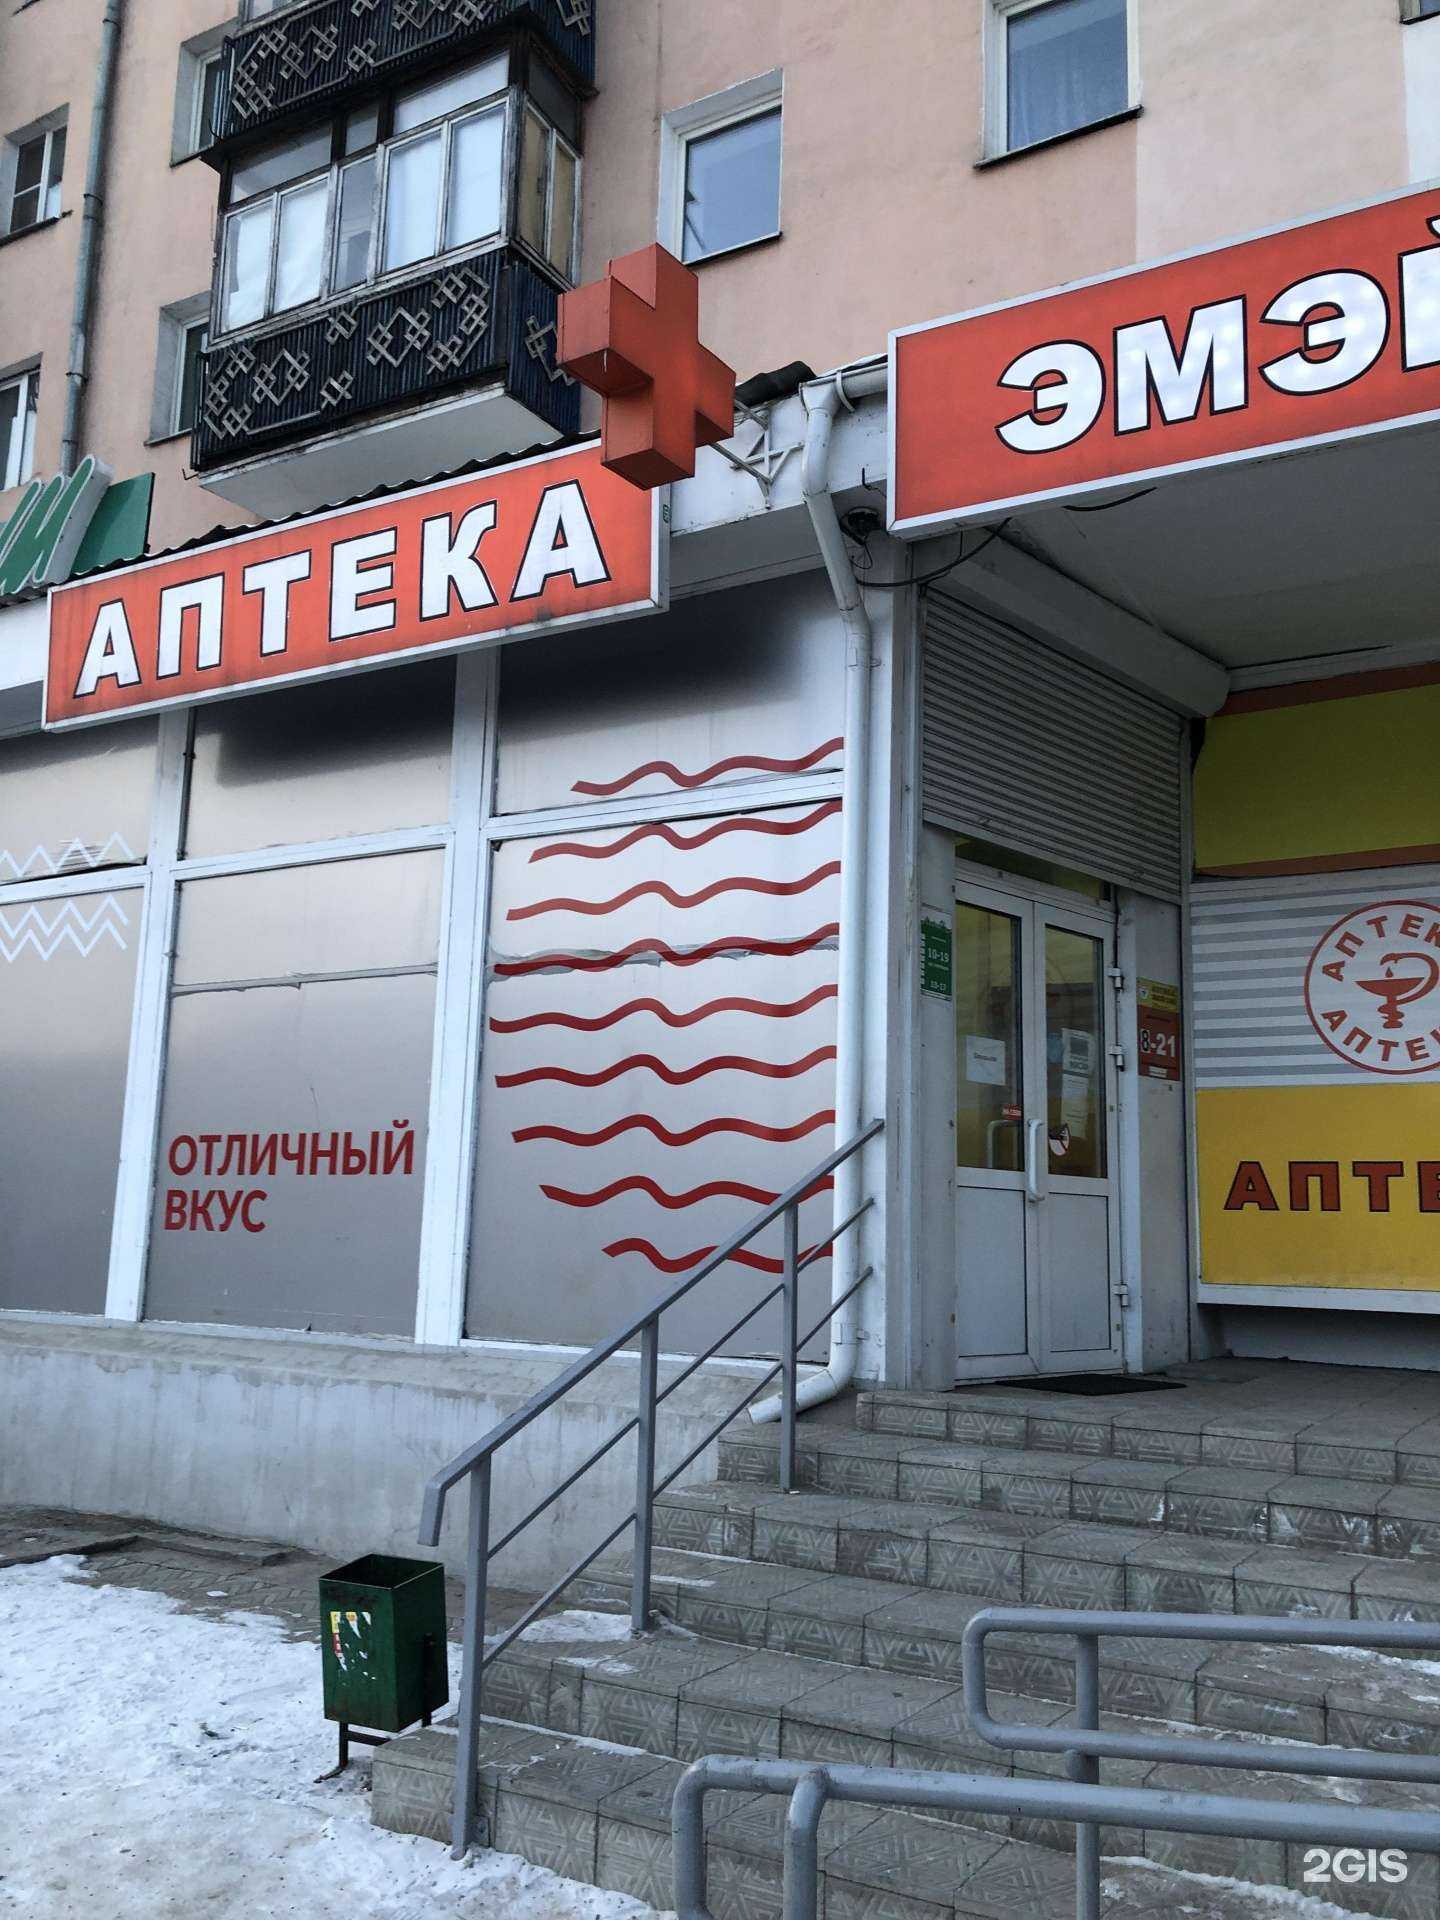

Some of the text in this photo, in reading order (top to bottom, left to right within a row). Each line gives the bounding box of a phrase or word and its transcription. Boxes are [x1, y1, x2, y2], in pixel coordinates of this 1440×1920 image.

[73, 479, 612, 699] АПТЕКА
[1140, 1028, 1176, 1058] 8-21
[1320, 1010, 1440, 1063] АПТЕ
[168, 1119, 415, 1176] ОТЛИЧНЫЙ
[164, 1189, 268, 1233] ВКУС
